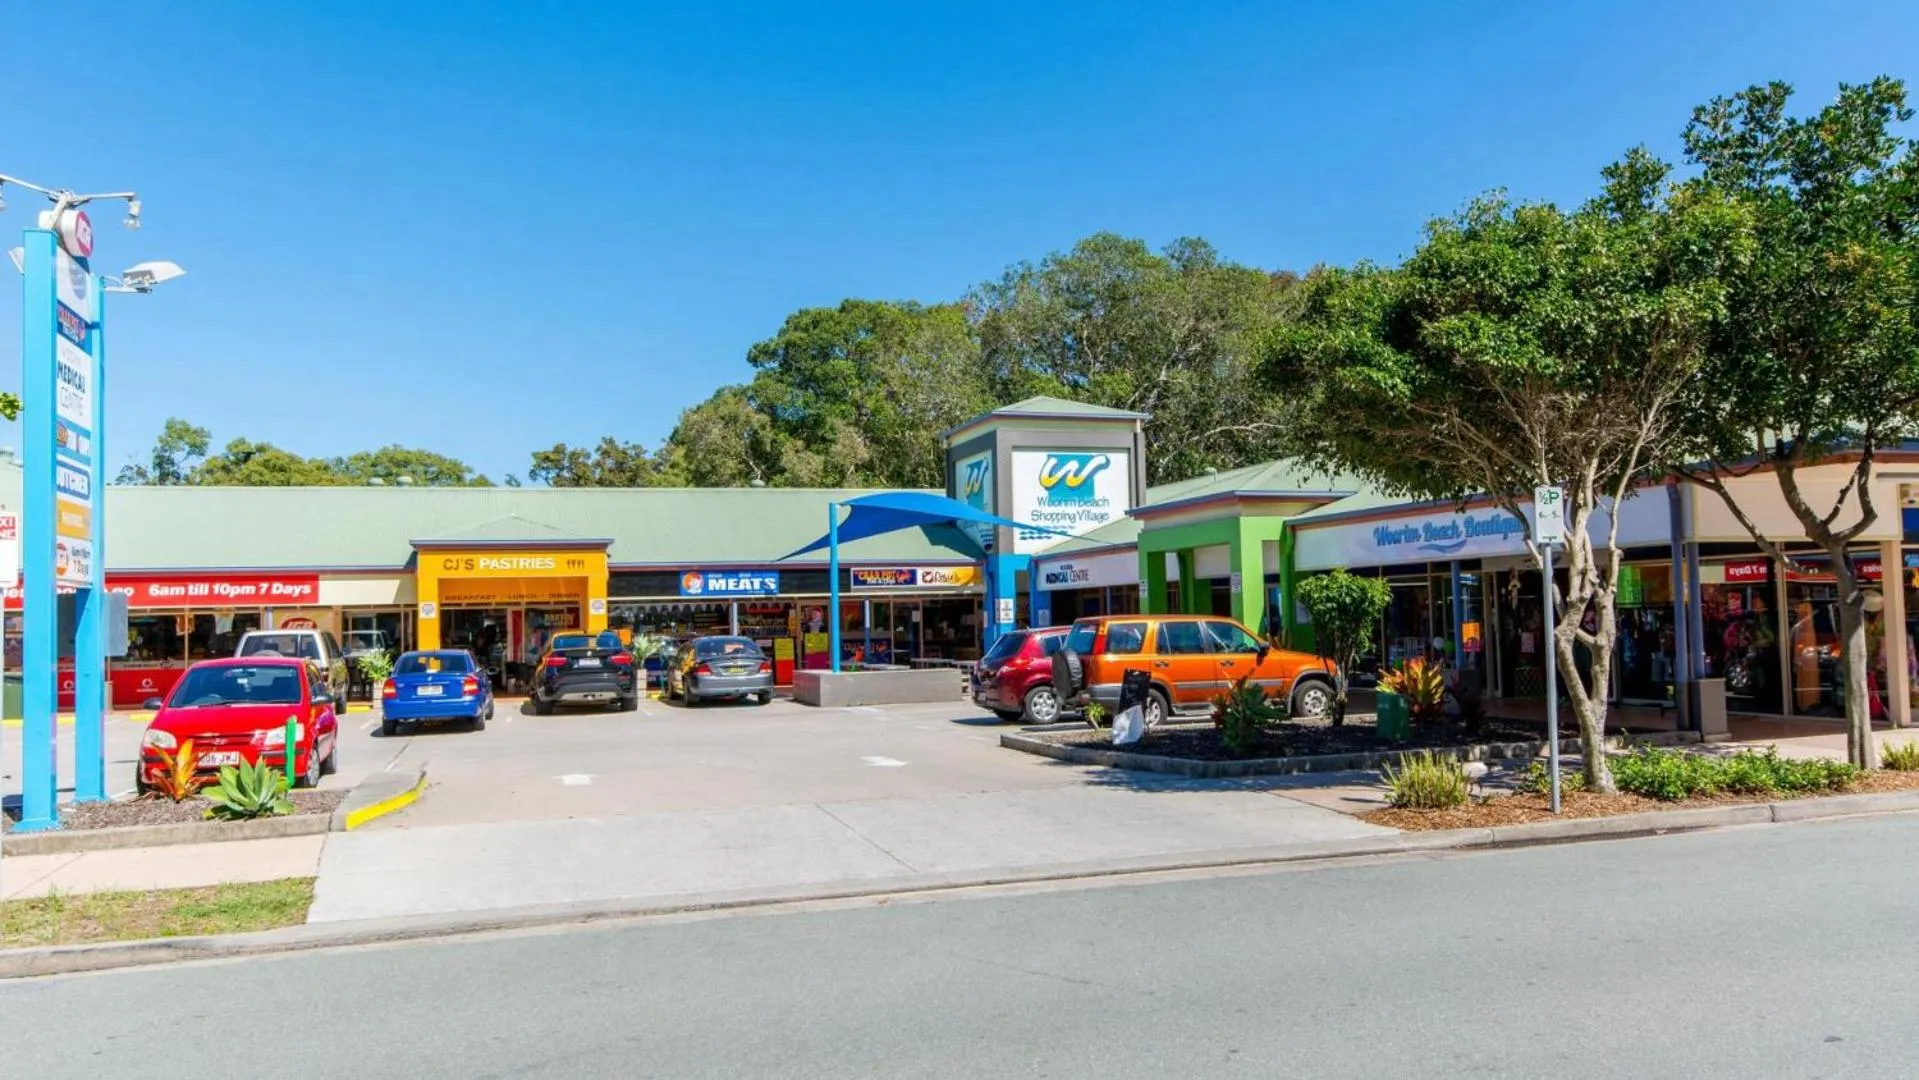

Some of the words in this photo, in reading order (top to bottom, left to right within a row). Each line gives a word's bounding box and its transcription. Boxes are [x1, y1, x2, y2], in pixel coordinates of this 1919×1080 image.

[1031, 509, 1076, 523] Shopping
[1077, 509, 1110, 523] Village
[443, 558, 475, 571] CJ'S
[479, 557, 555, 570] PASTRIES
[148, 584, 184, 597] 6am
[187, 583, 209, 596] till
[213, 583, 256, 597] 10pm
[259, 583, 269, 595] 7
[271, 582, 311, 597] Days
[708, 577, 776, 591] MEATS
